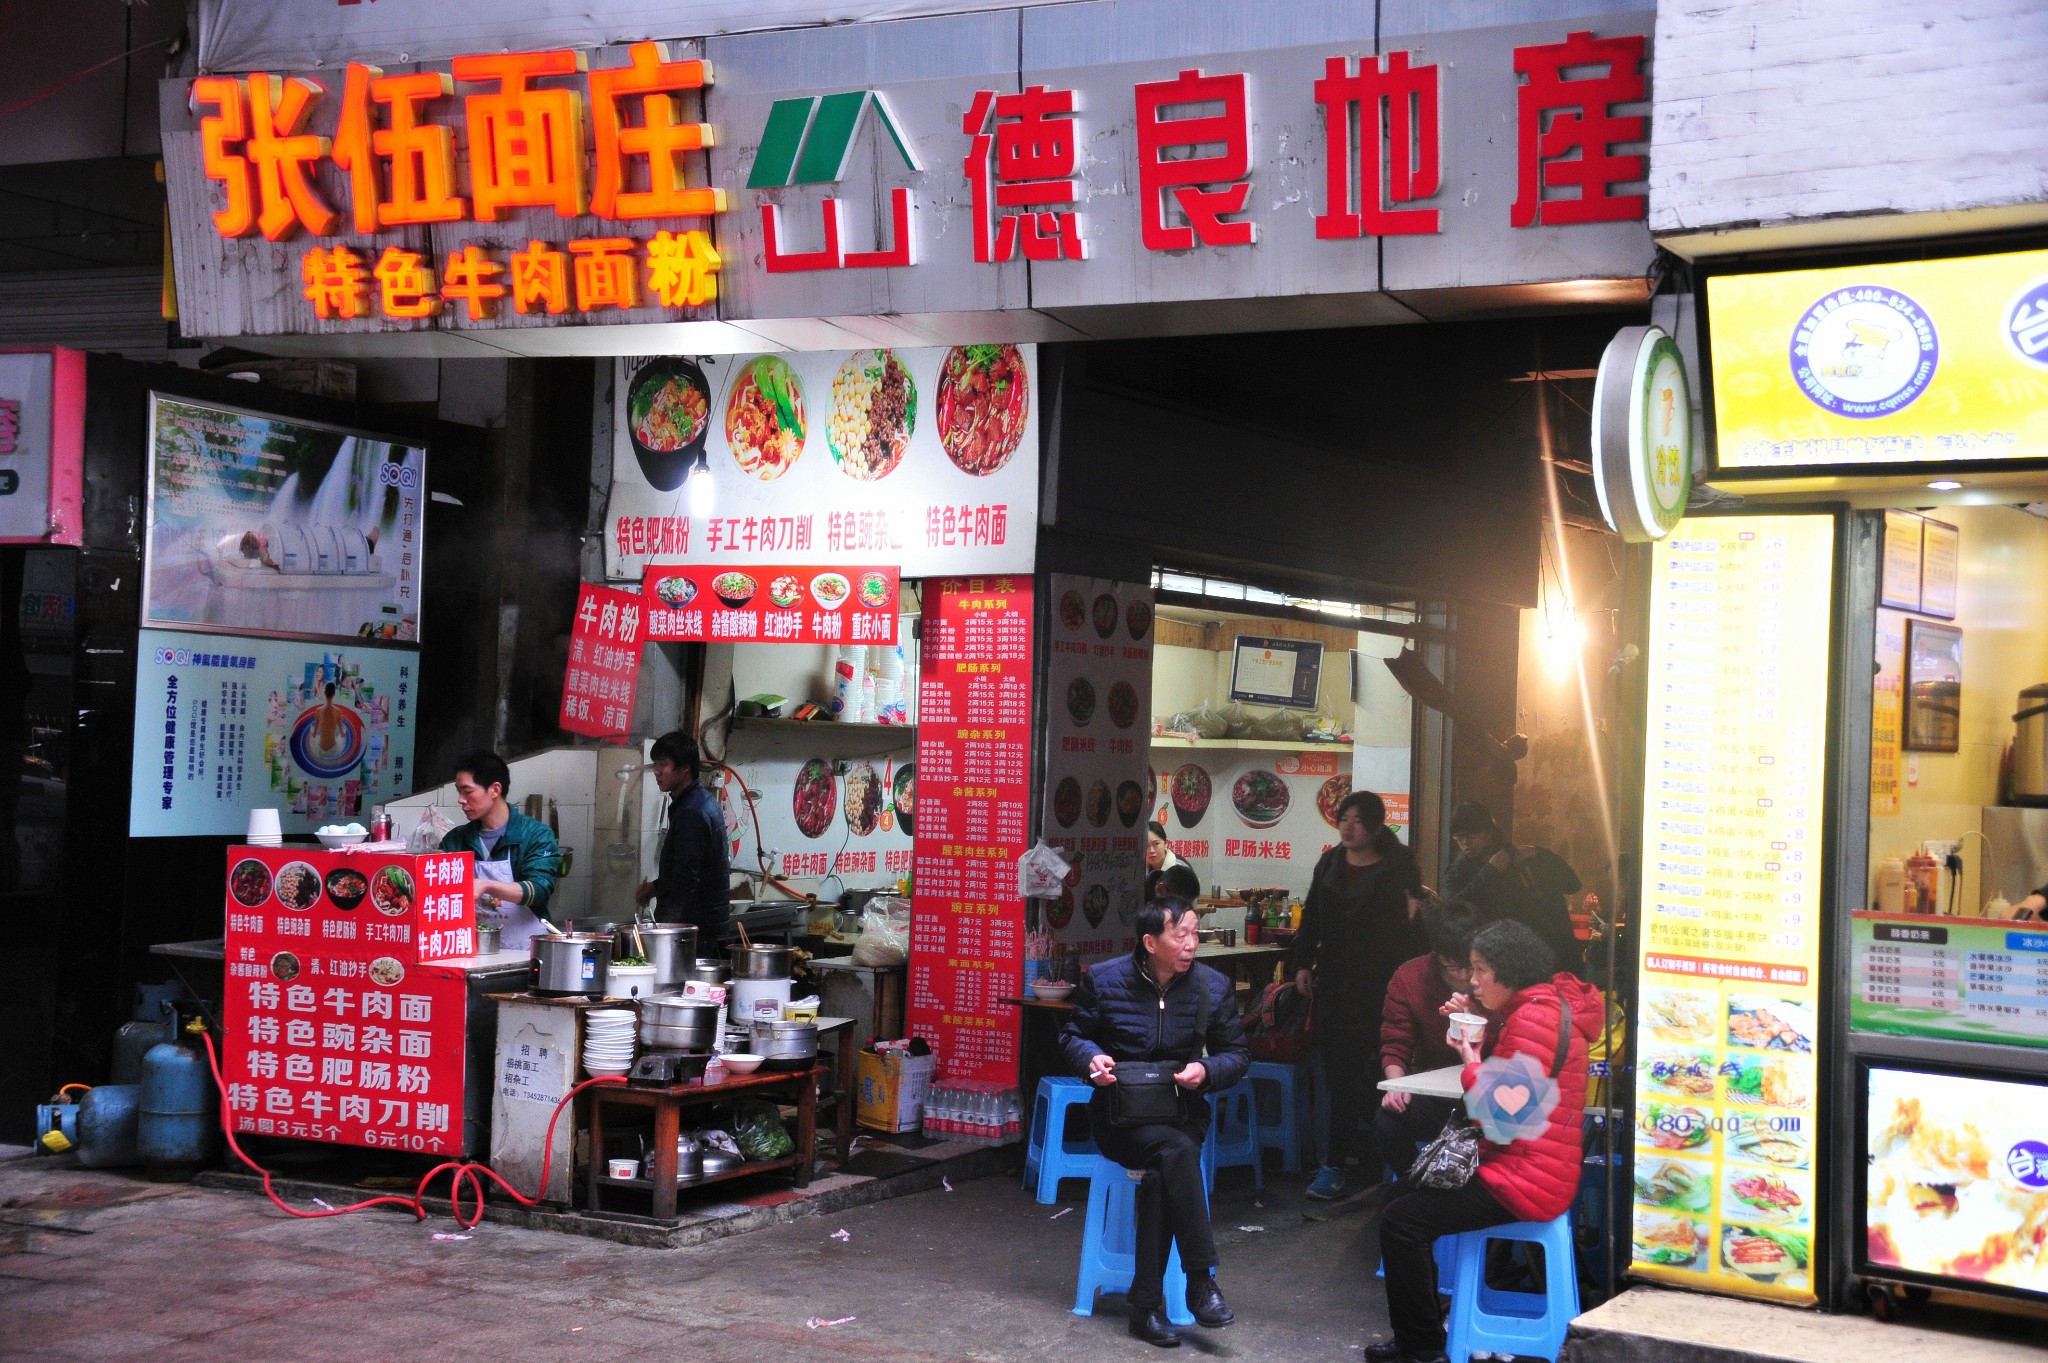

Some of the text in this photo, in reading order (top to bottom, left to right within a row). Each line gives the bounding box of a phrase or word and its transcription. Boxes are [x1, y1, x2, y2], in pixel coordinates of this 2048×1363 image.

[194, 40, 727, 240] 张伍面庄
[962, 31, 1645, 263] 德良地产
[302, 229, 721, 319] 特色牛肉面粉
[380, 463, 417, 488] SOQI
[616, 515, 690, 555] 特色肥肠粉
[706, 513, 814, 553] 手工牛肉刀削
[925, 503, 1008, 548] 特色牛肉面
[941, 578, 1016, 595] 价目表
[959, 599, 1007, 610] 牛肉系列
[579, 594, 639, 644] 牛肉粉
[650, 609, 891, 641] 酸菜肉丝米线 杂酱酸辣粉 红油抄手 牛肉粉 重庆小面
[155, 647, 191, 666] SOQI
[572, 637, 636, 675] 清、红油抄手
[956, 663, 1001, 673] 肥肠系列
[568, 668, 631, 706] 酸菜肉丝米线
[565, 695, 628, 731] 稀饭、凉面
[994, 751, 1023, 759] 3两12元
[964, 767, 1023, 776] 2两10元 3两12元
[1301, 764, 1333, 773] 小心地滑
[953, 787, 997, 798] 杂酱系列
[967, 800, 989, 808] 2两8元
[997, 810, 1023, 818] 3两10元
[996, 836, 1022, 844] 3两10元
[997, 827, 1022, 835] 3两10元
[942, 844, 1008, 858] 酸菜肉丝系列
[1225, 838, 1292, 860] 肥肠米线
[424, 858, 464, 887] 牛肉粉
[782, 852, 828, 876] 特色牛肉面
[422, 893, 463, 923] 牛肉面
[951, 902, 999, 915] 豌豆系列
[230, 914, 411, 944] 特色牛肉面 特色豌杂面 特色肥肠粉 手工牛肉刀削
[958, 917, 1014, 928] 2两7元 3两9元
[958, 928, 981, 936] 2两7元
[990, 930, 1014, 938] 3两9元
[418, 927, 472, 959] 牛肉刀削
[957, 948, 981, 956] 2两7元
[989, 950, 1013, 959] 3两9元
[958, 938, 1013, 949] 2两7元 3两9元
[240, 947, 256, 961] 特色
[310, 958, 367, 978] 清、红油抄手
[248, 981, 433, 1023] 特色牛肉面
[248, 1016, 432, 1059] 特色豌杂面
[247, 1050, 431, 1094] 特色肥肠粉
[504, 1073, 530, 1086] 招杂工
[227, 1083, 449, 1133] 特色牛肉刀削
[238, 1115, 445, 1153] 汤圆3元5个 6元10个
